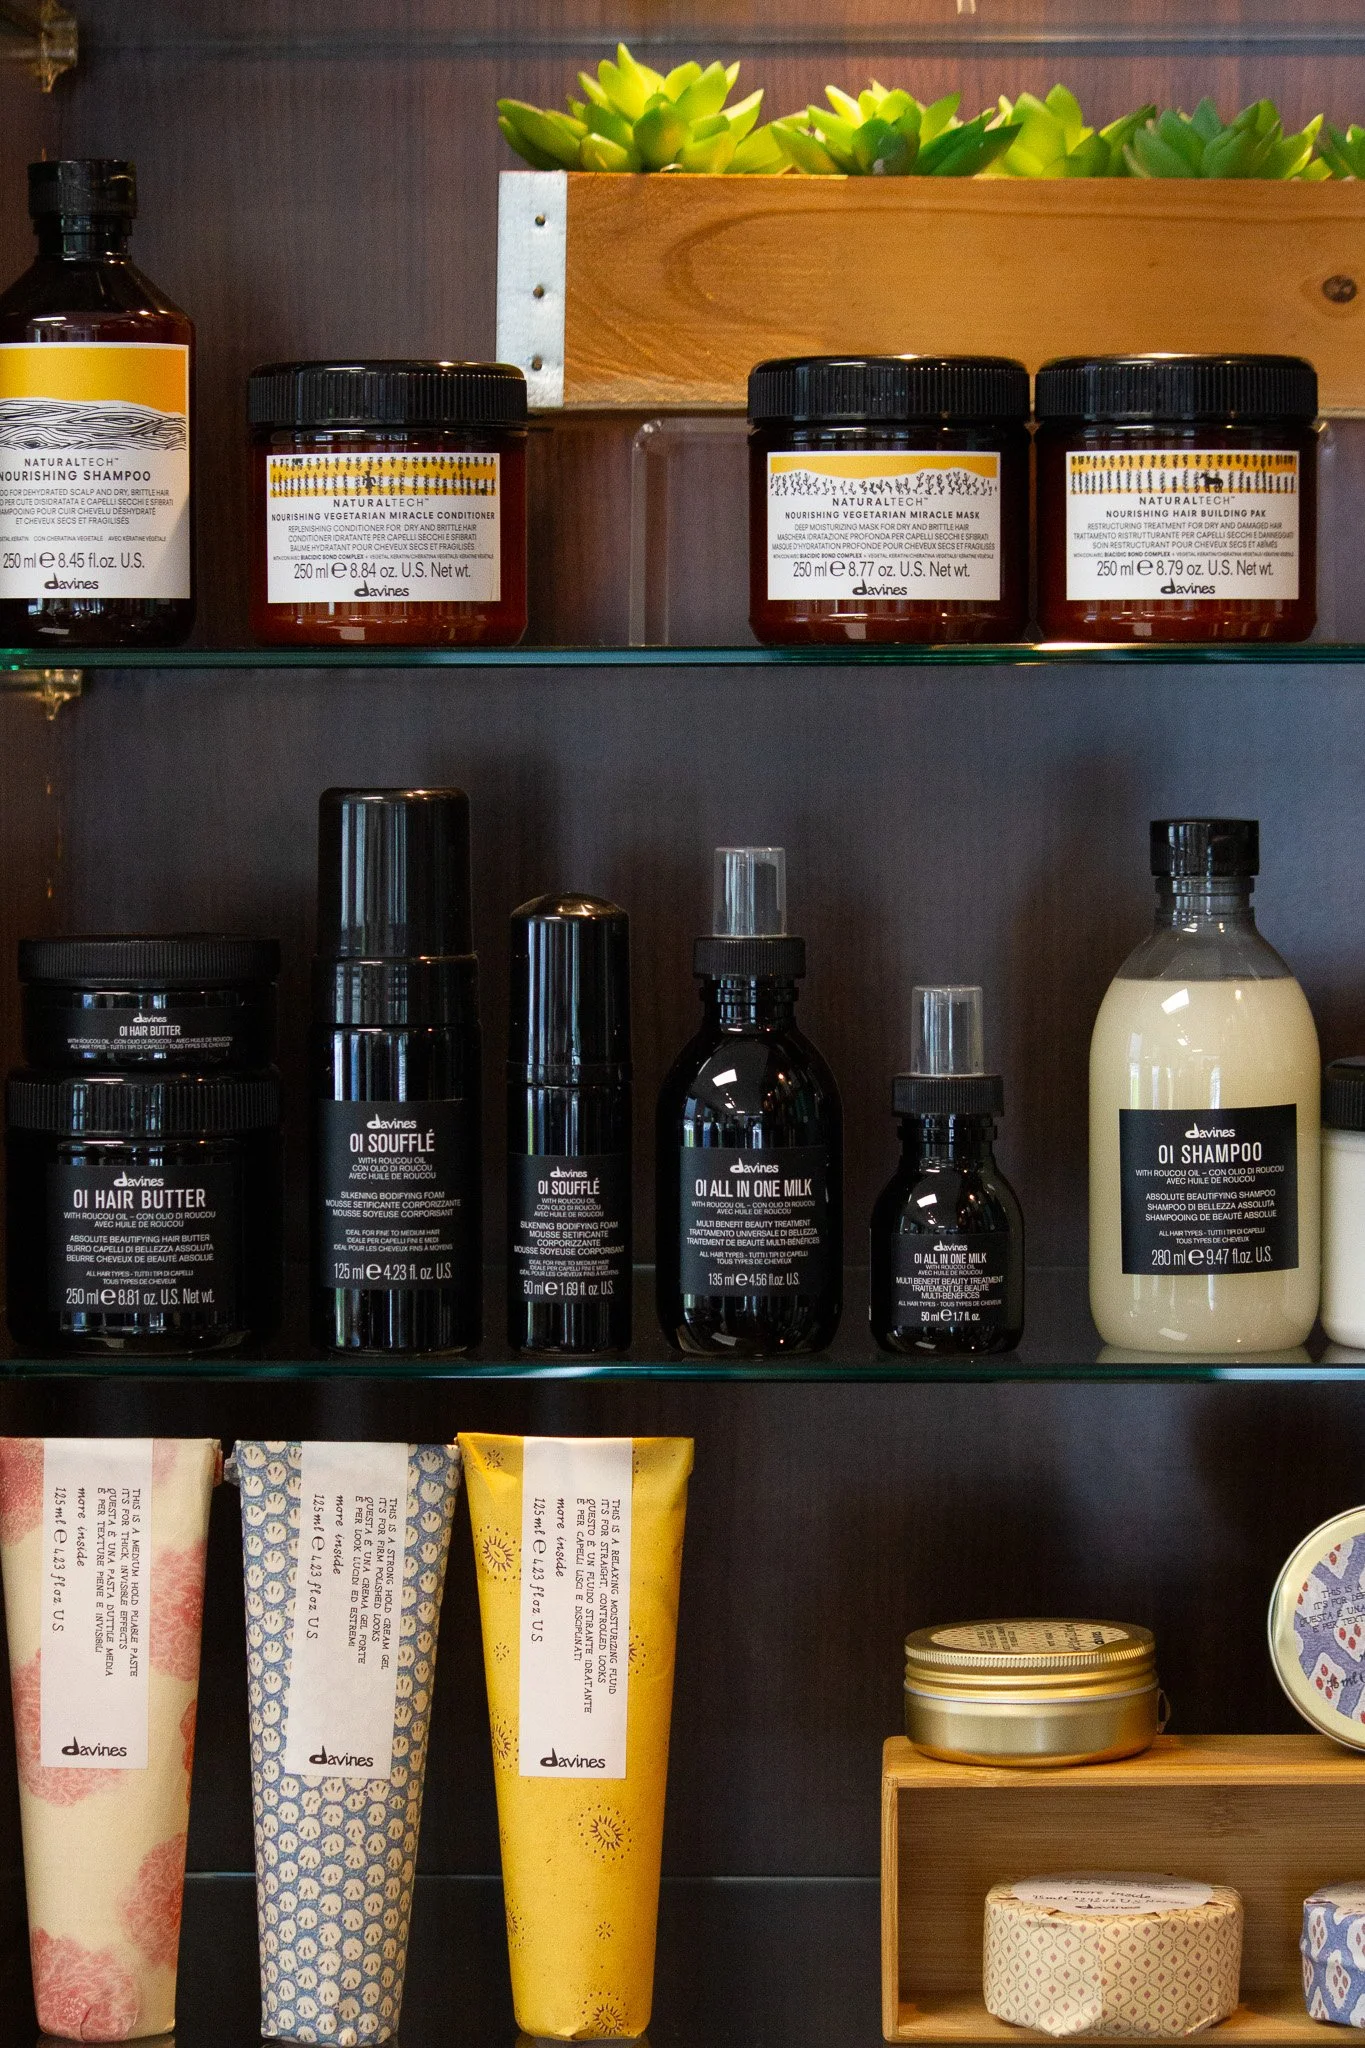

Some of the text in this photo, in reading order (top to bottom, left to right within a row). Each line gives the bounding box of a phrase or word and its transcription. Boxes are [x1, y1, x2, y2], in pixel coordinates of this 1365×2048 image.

[83, 470, 151, 481] SHAMPOO
[272, 511, 495, 522] NOURISHING VEGETARIAN MIRACLE CONDITIONER
[785, 511, 980, 520] NOURISHING VEGETARIAN MIRACLE MASK
[1106, 510, 1266, 518] NOURISHING HAIR BUILDING PAK
[288, 524, 477, 533] REPLENISHING CONDITIONER FOR DRY AND BRITTLE HAIR
[3, 553, 21, 568] 250
[23, 553, 37, 568] ml
[58, 553, 85, 568] 8.45
[793, 562, 812, 577] 250
[814, 561, 827, 577] ml
[849, 561, 874, 576] 8.77
[929, 561, 952, 577] Net
[953, 562, 970, 577] wt.
[1097, 560, 1118, 576] 250
[1120, 560, 1134, 576] ml
[1156, 559, 1183, 576] 8.79
[1236, 559, 1257, 576] Net
[1258, 561, 1274, 576] wt.
[294, 563, 313, 579] 250
[316, 562, 329, 579] ml
[350, 562, 376, 578] 8.84
[431, 562, 452, 578] Net
[455, 563, 471, 578] wt.
[44, 573, 99, 590] davines
[354, 580, 410, 598] davines
[852, 579, 908, 596] davines
[1160, 578, 1215, 594] davines
[132, 1013, 167, 1023] davines
[119, 1025, 181, 1036] OI HAIR BUTTER
[367, 1113, 417, 1129] davines
[1184, 1123, 1236, 1138] davines
[350, 1129, 435, 1153] OI SOUFFLÉ
[1158, 1141, 1262, 1164] OI SHAMPOO
[550, 1166, 588, 1178] davines
[730, 1157, 779, 1173] davines
[113, 1171, 164, 1187] davines
[538, 1177, 600, 1195] OI SOUFFLÉ
[340, 1191, 445, 1200] SILKENING BODIFYING FOAM
[695, 1178, 812, 1198] OI ALL IN ONE MILK
[1145, 1189, 1276, 1201] ABSOLUTE BEAUTIFYING SHAMPOO
[73, 1189, 206, 1209] OI HAIR BUTTER
[69, 1234, 210, 1243] ABSOLUTE BEAUTIFYING HAIR BUTTER
[933, 1240, 968, 1252] davines
[914, 1252, 987, 1264] OI ALL IN ONE MILK
[1151, 1249, 1171, 1266] 280
[1174, 1249, 1186, 1266] ml
[1206, 1248, 1229, 1265] 9.47
[334, 1263, 350, 1280] 125
[352, 1263, 364, 1280] ml
[383, 1263, 406, 1281] 4.23
[708, 1273, 723, 1286] 135
[724, 1273, 735, 1286] ml
[749, 1273, 767, 1286] 4.56
[66, 1288, 85, 1305] 250
[86, 1288, 99, 1305] ml
[118, 1289, 140, 1306] 8.81
[183, 1288, 200, 1304] Net
[201, 1289, 215, 1304] wt.
[132, 1488, 141, 1510] THIS
[388, 1498, 397, 1520] THIS
[611, 1499, 620, 1520] THIS
[76, 1487, 88, 1567] more inside
[132, 1514, 140, 1523] IS
[333, 1495, 345, 1575] more inside
[388, 1524, 396, 1532] IS
[612, 1525, 620, 1533] IS
[555, 1498, 567, 1578] more inside
[131, 1539, 140, 1577] MEDIUM
[386, 1549, 396, 1585] STRONG
[610, 1549, 620, 1595] RELAXING
[131, 1582, 139, 1606] HOLD
[384, 1589, 393, 1613] HOLD
[130, 1610, 139, 1643] PLIABLE
[382, 1618, 391, 1650] CREAM
[609, 1599, 619, 1664] MOISTURIZING
[129, 1648, 138, 1677] PASTE
[380, 1654, 389, 1670] GEL
[608, 1668, 617, 1695] FLUID
[61, 1737, 127, 1757] davines
[309, 1745, 374, 1767] davines
[540, 1748, 606, 1769] davines
